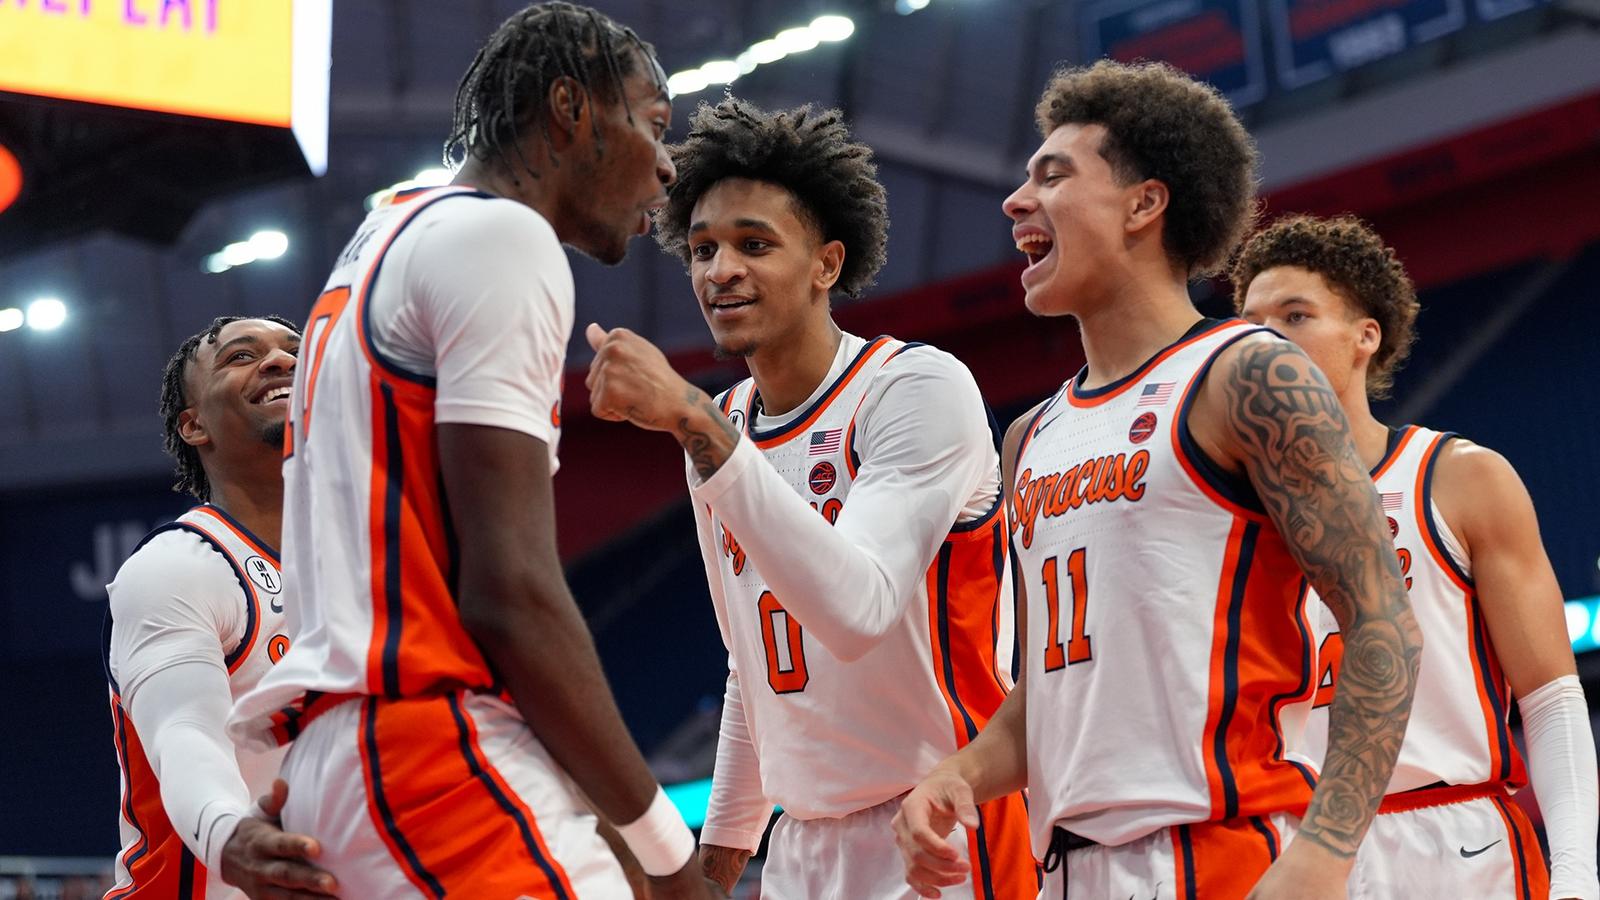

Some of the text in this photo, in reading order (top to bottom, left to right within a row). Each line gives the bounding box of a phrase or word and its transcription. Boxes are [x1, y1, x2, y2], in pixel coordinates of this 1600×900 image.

[1011, 449, 1151, 549] Syracuse
[260, 572, 276, 589] 21
[1042, 547, 1093, 673] 11
[758, 590, 809, 695] 0
